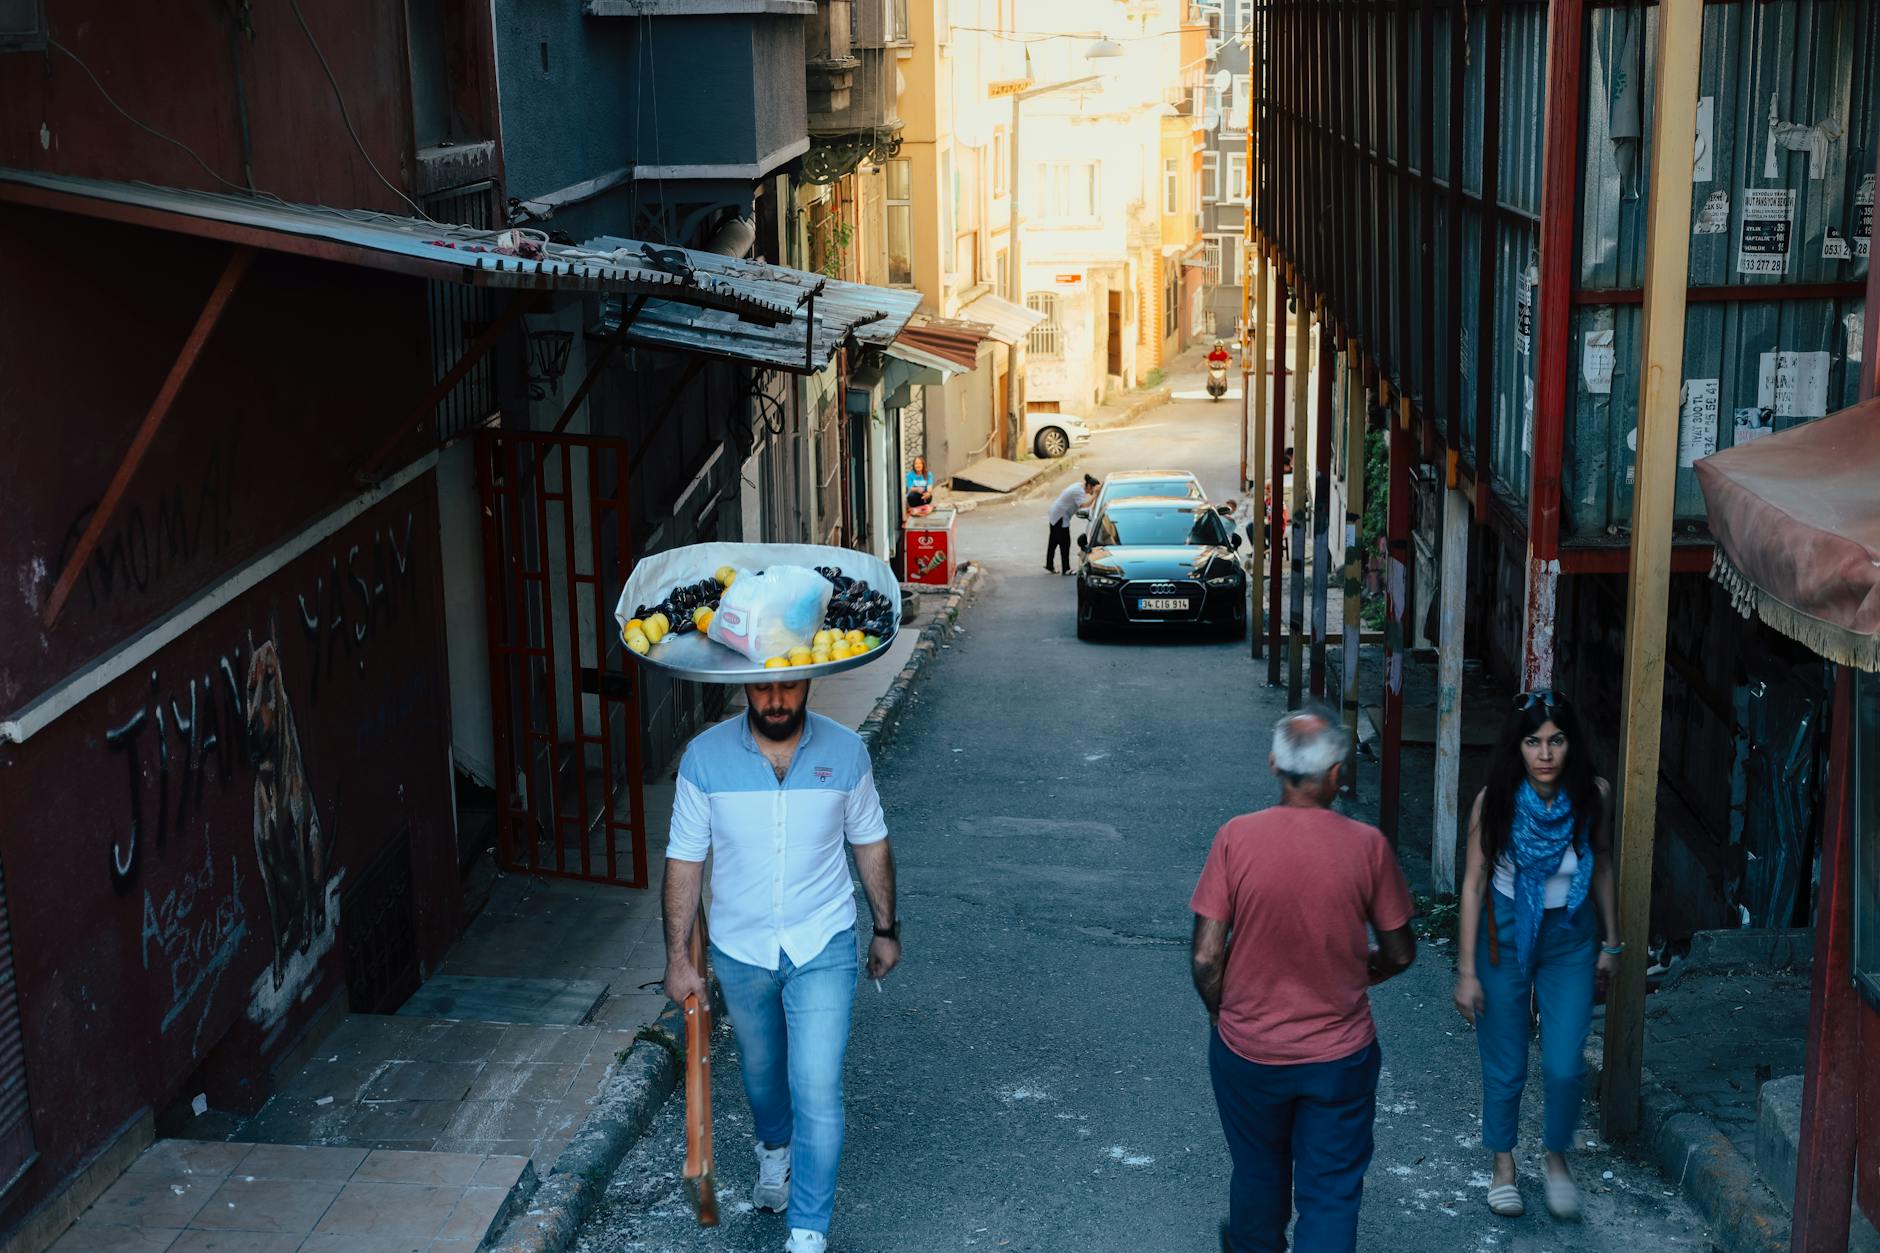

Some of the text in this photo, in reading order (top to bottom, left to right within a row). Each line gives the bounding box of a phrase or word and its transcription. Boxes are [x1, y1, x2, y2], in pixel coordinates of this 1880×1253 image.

[1755, 260, 1770, 271] 277
[1142, 600, 1153, 609] 34
[1172, 600, 1188, 609] 914
